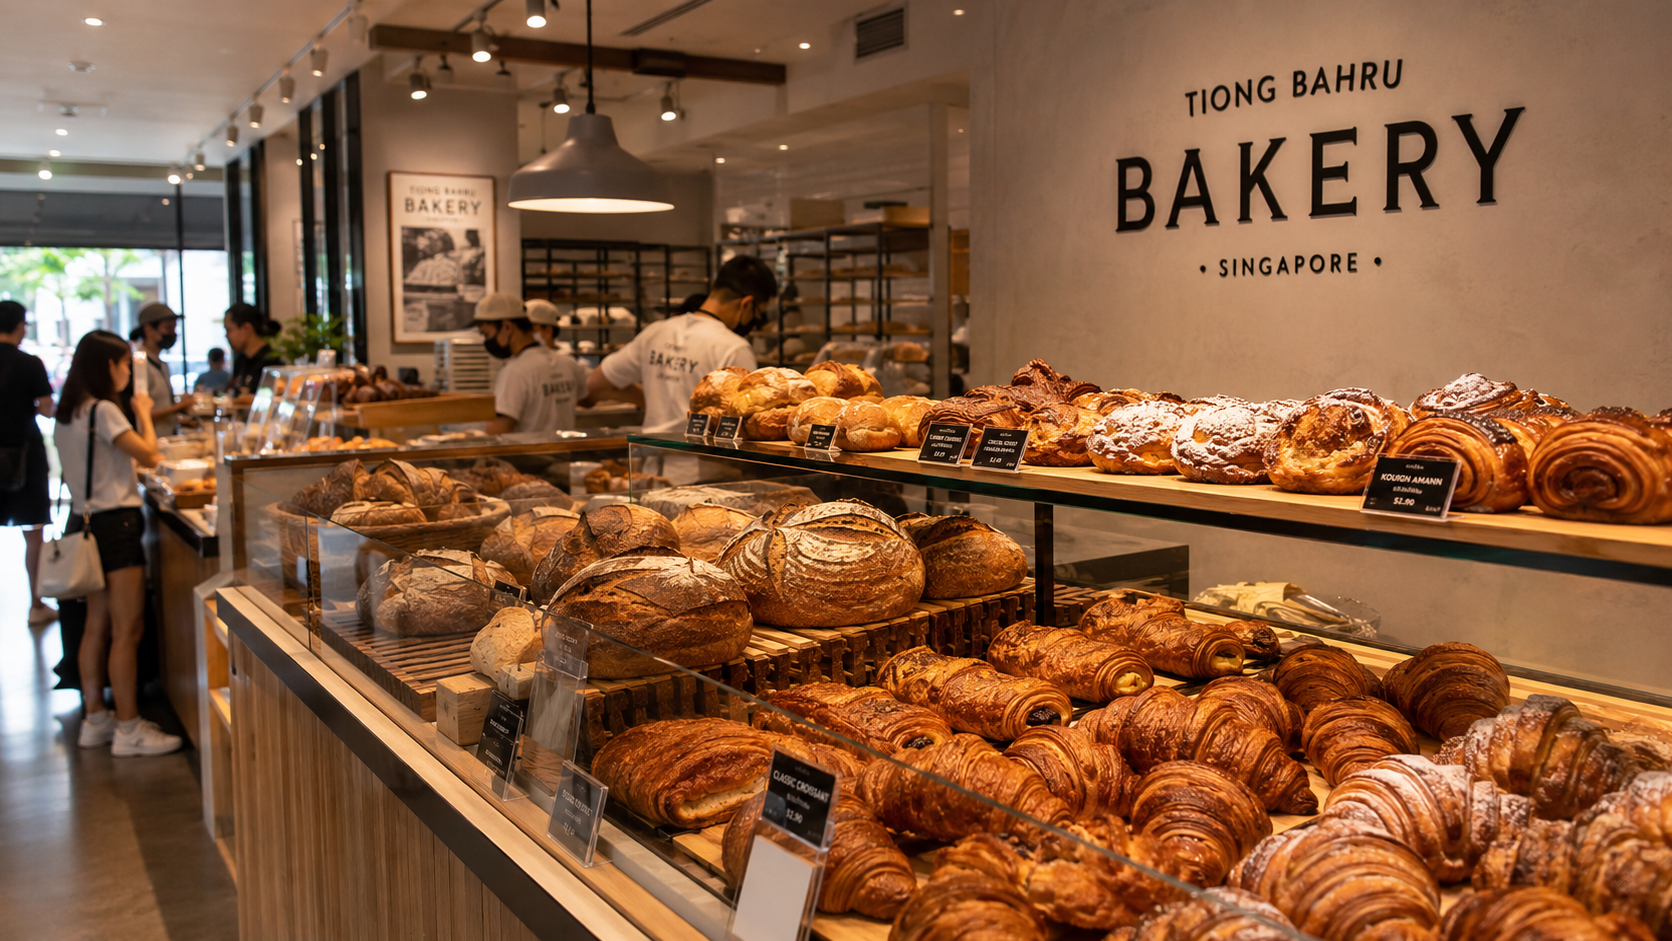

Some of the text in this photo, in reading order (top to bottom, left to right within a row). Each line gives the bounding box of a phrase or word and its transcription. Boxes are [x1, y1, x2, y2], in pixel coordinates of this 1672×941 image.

[1185, 58, 1403, 118] TIONG BAHRU
[1115, 106, 1527, 233] BAKERY
[404, 197, 482, 216] BAKERY
[1218, 252, 1358, 277] SINGAPORE
[649, 350, 699, 374] BAKERY
[1380, 473, 1443, 486] KOUIGN AMANN
[773, 770, 797, 789] CLASSIC
[796, 780, 830, 803] CROISSANT
